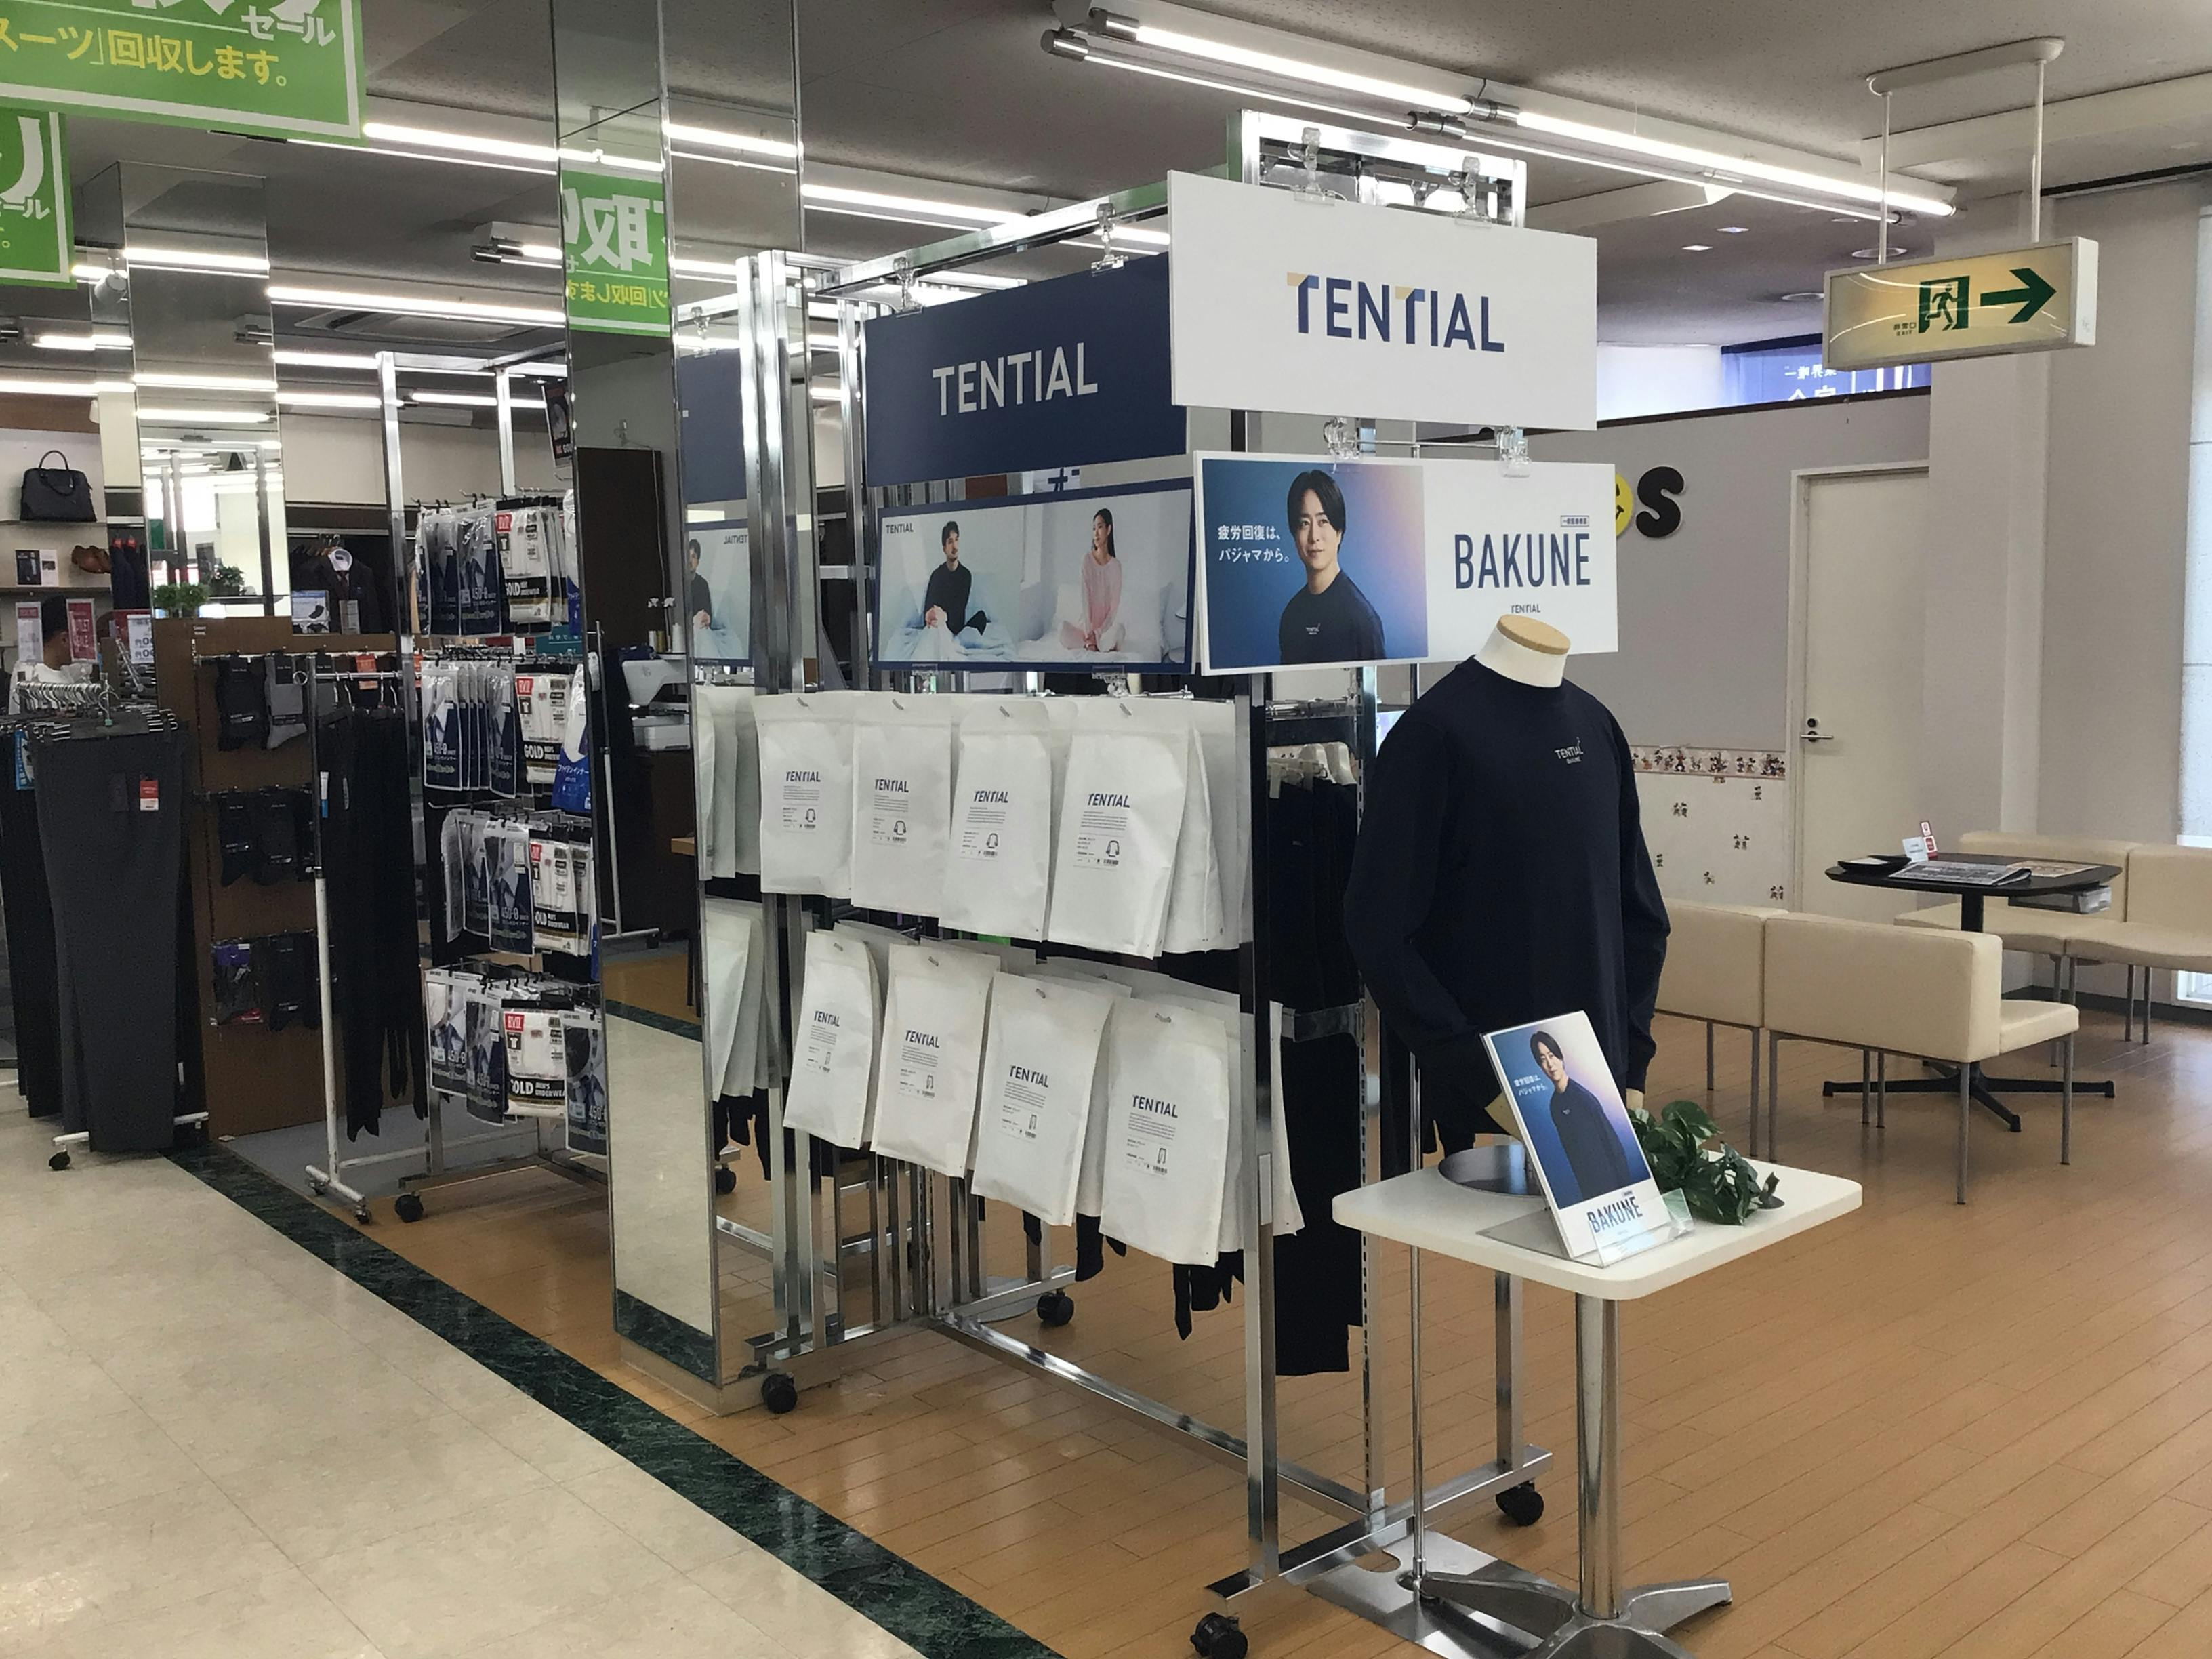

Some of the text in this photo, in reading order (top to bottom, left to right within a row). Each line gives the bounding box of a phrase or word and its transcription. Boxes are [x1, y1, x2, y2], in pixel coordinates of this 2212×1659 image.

[241, 5, 337, 47] セール
[1286, 272, 1504, 353] TENTIAL
[932, 342, 1099, 416] TENTIAL
[886, 523, 914, 534] TENTIAL
[1218, 525, 1281, 541] 疲労回復は、
[1218, 547, 1290, 563] パジャマから。
[1455, 533, 1591, 590] BAKUNE
[1511, 604, 1541, 613] TENTIAL
[524, 744, 544, 759] GOLD
[1554, 742, 1584, 760] TENTIAL
[786, 771, 821, 782] TENTIAL
[874, 779, 909, 793] TENTIAL
[973, 790, 1009, 804] TENTIAL
[1087, 793, 1131, 808] TENTIAL
[813, 1010, 840, 1027] TENTIAL
[905, 1029, 940, 1048] TENTIAL
[1010, 1065, 1049, 1088] TENTIAL
[1132, 1095, 1179, 1119] TENTIAL
[1586, 1196, 1643, 1233] BAKUNE
